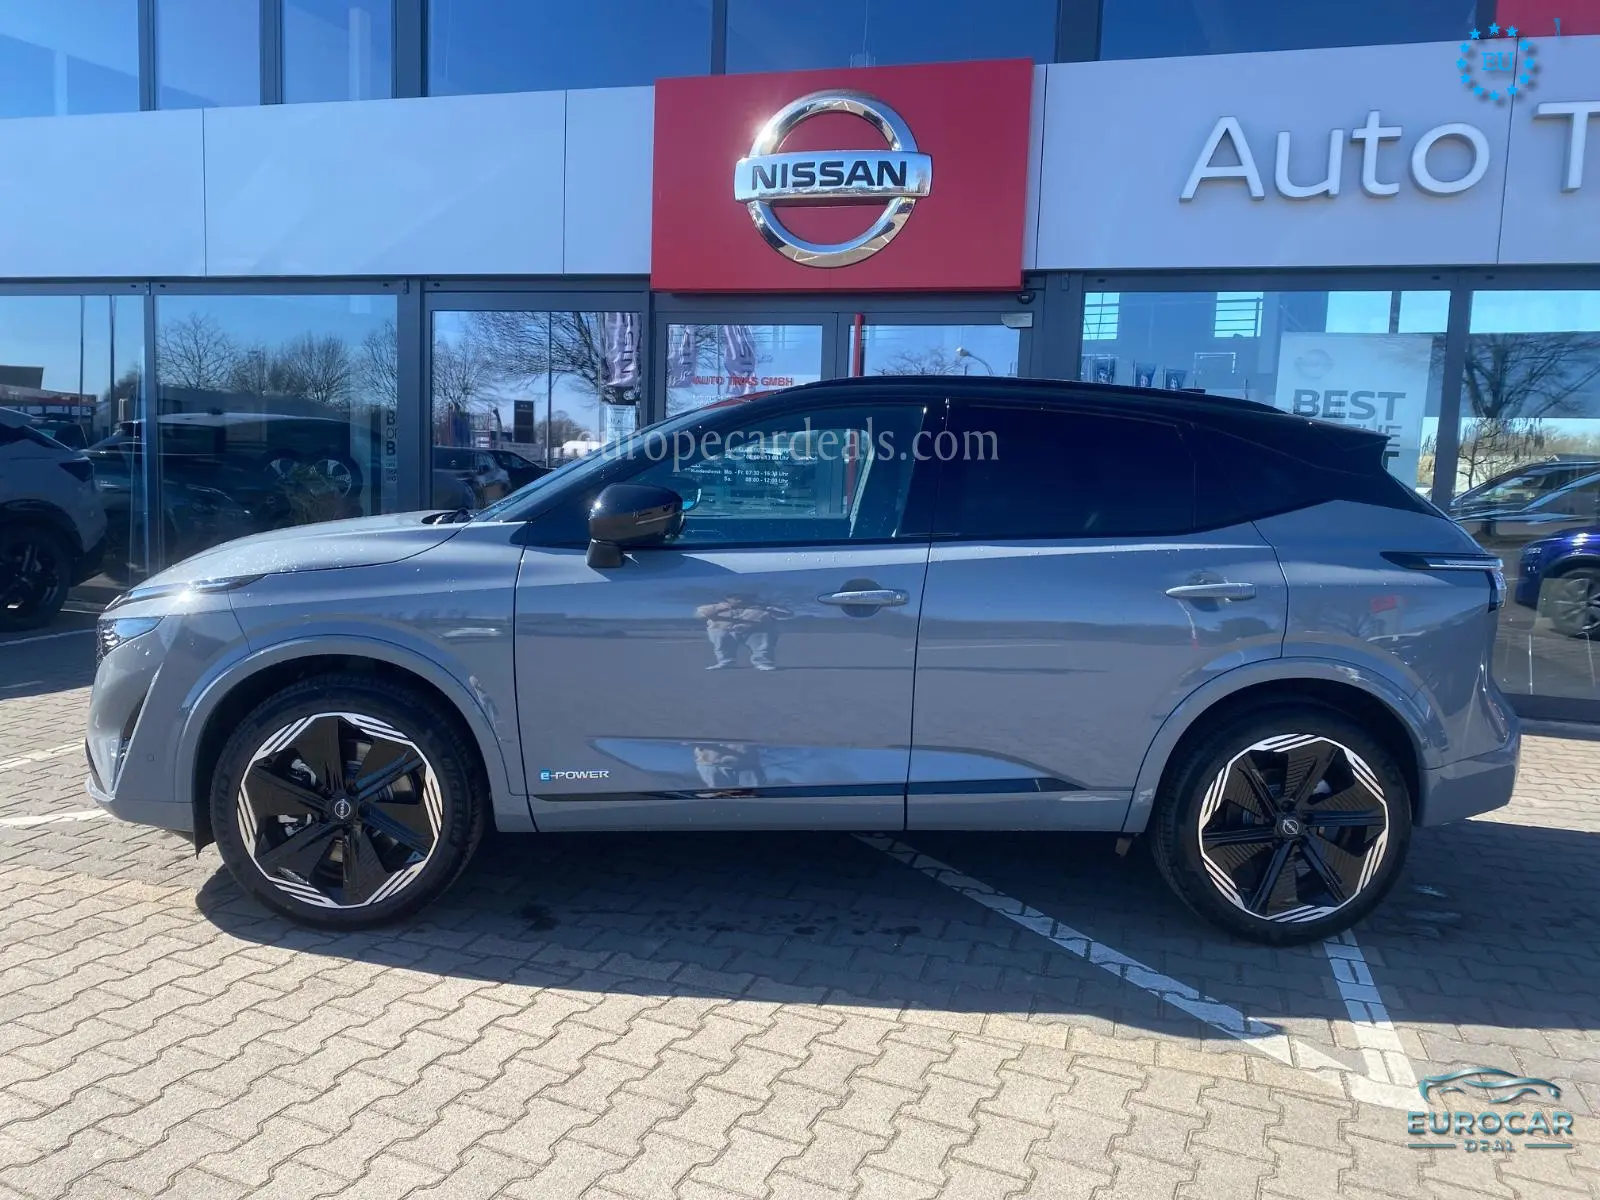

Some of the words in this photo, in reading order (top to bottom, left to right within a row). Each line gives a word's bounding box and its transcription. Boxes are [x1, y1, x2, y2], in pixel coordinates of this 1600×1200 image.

[1179, 109, 1491, 203] Auto
[751, 160, 907, 190] NISSAN
[761, 376, 793, 386] GMBH
[1293, 389, 1406, 420] BEST
[540, 769, 609, 781] e-POWER
